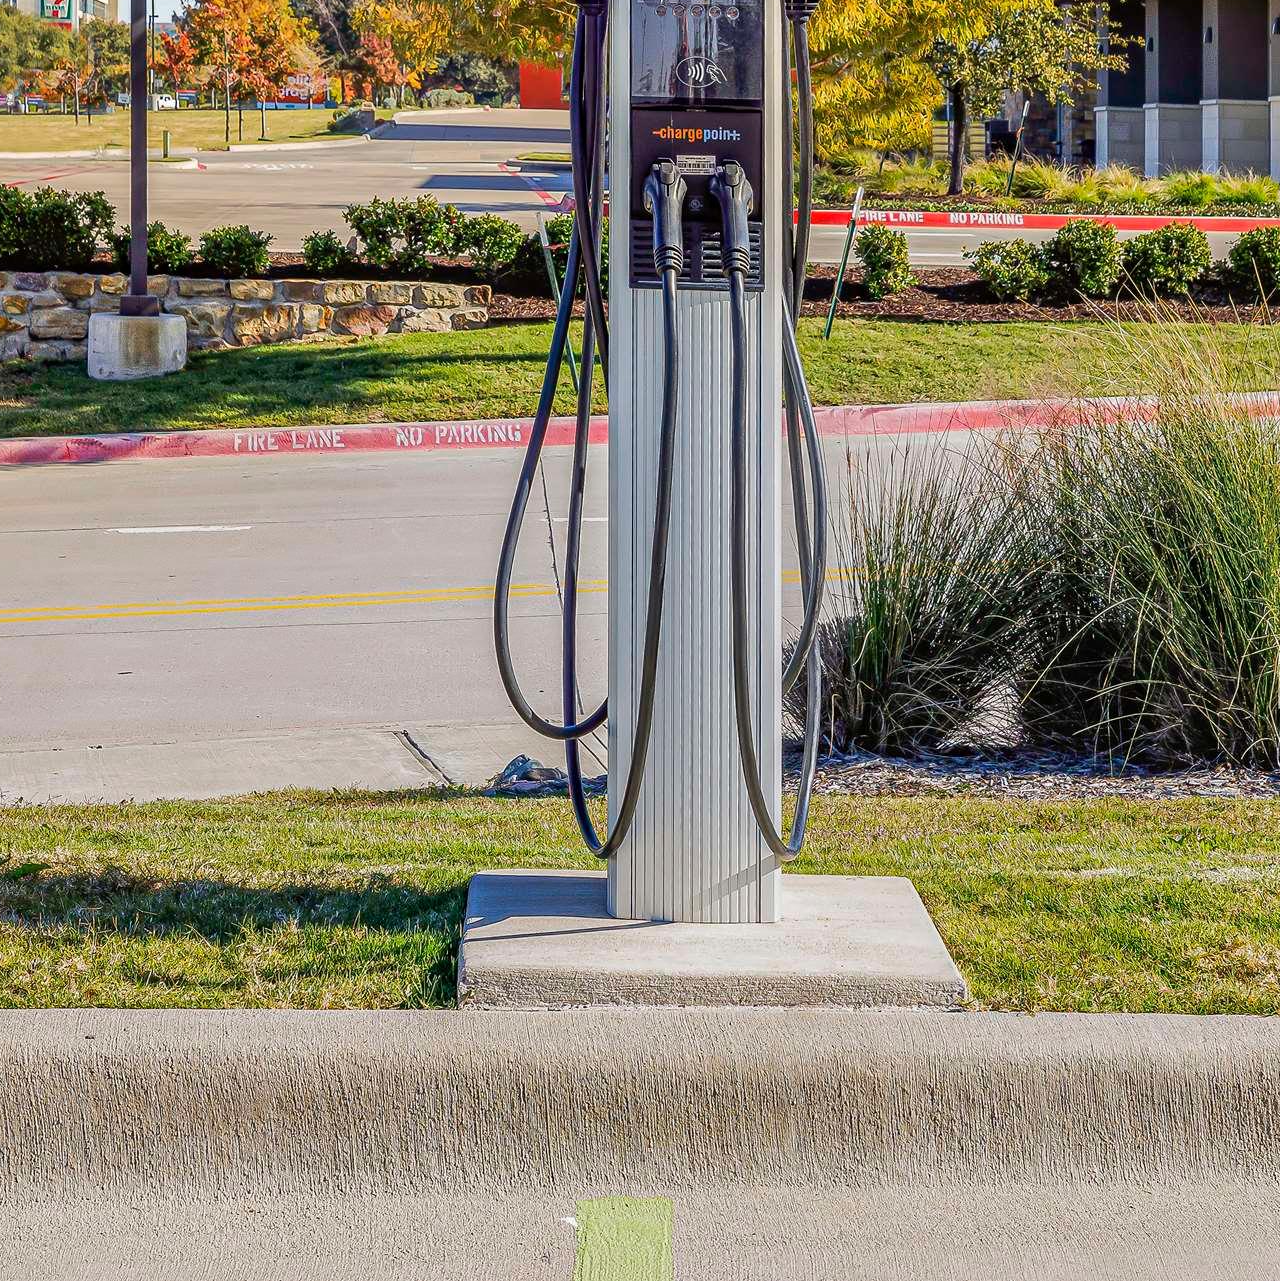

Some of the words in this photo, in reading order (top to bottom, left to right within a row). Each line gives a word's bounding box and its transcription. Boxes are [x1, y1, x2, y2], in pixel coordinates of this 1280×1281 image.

[858, 211, 887, 222] FIRE
[887, 212, 924, 223] LANE
[949, 213, 967, 224] NO
[970, 213, 1024, 225] PARKING
[233, 431, 279, 452] FIRE
[291, 429, 345, 449] LANE
[395, 427, 423, 447] NO
[435, 424, 522, 444] PARKING
